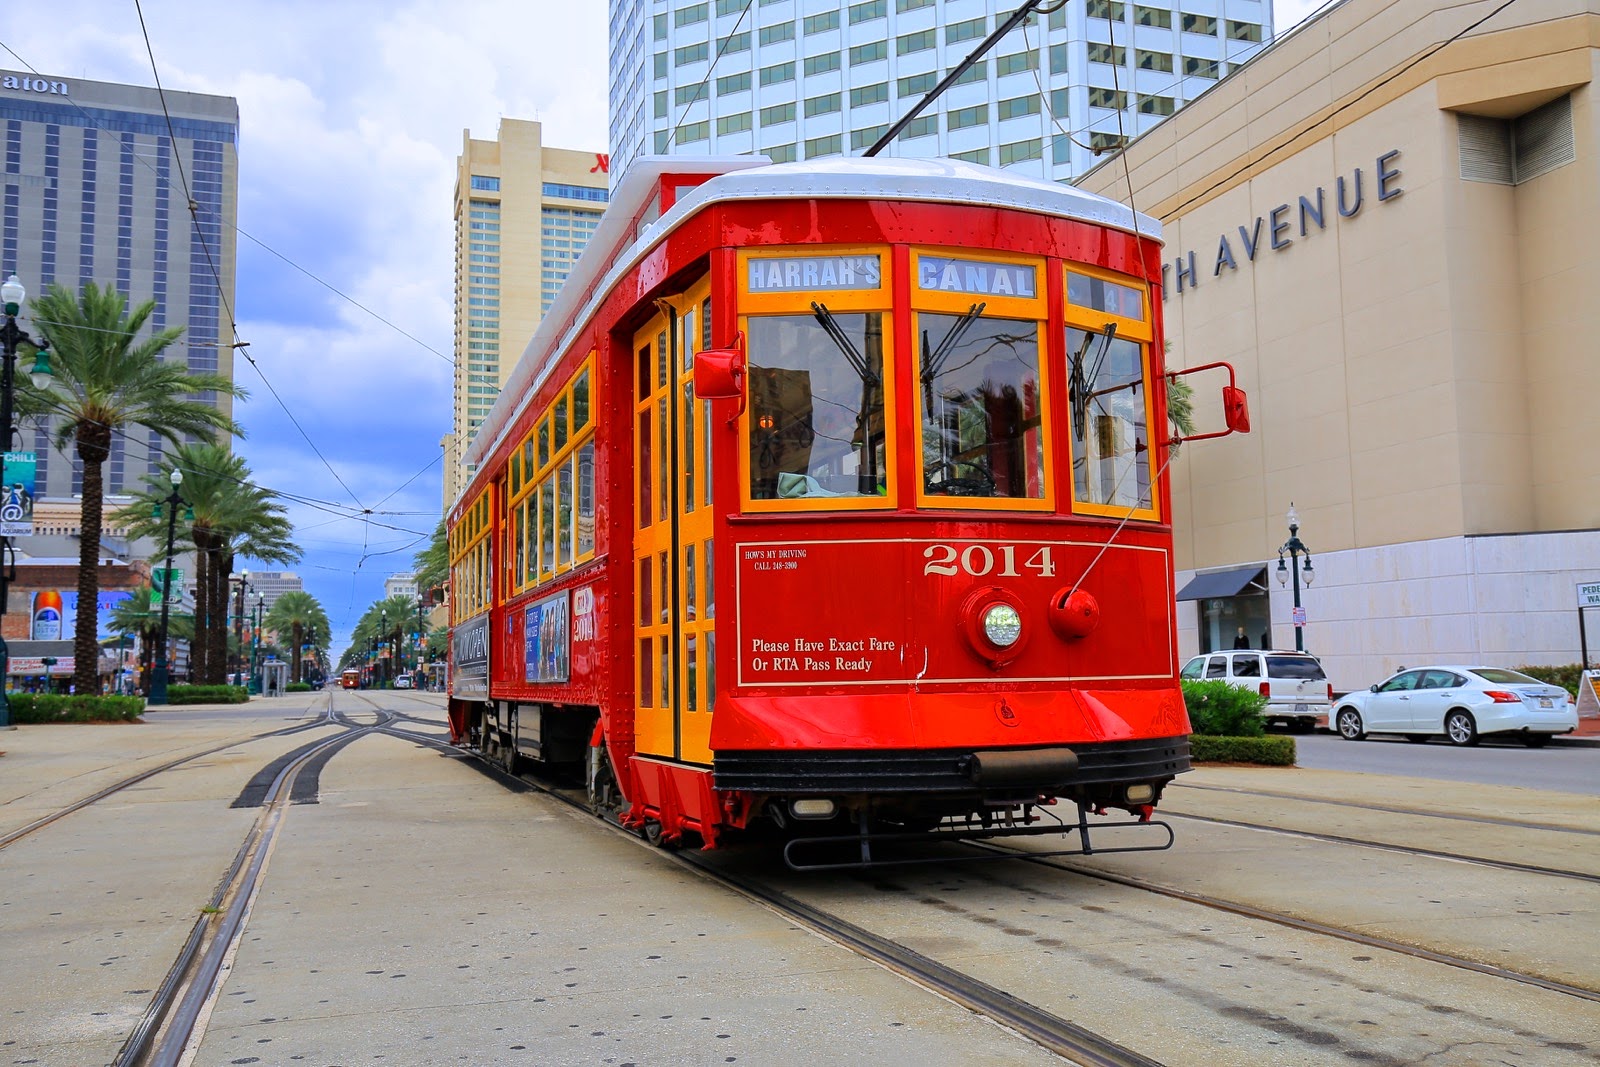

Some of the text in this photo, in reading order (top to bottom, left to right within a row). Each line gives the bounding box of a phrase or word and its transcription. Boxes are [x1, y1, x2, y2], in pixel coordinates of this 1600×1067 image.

[0, 75, 69, 96] aton
[1214, 149, 1404, 276] AVENUE
[749, 257, 881, 289] HARRAH'S
[918, 261, 1034, 297] CANAL
[4, 453, 37, 463] CHILL
[745, 549, 807, 560] HOW'S MY DRIVING
[923, 544, 1056, 577] 2014
[754, 561, 771, 570] CALL
[573, 617, 593, 642] 2014
[752, 637, 895, 652] Please Have Exact Fare
[752, 657, 873, 672] Or RTA Pass Ready
